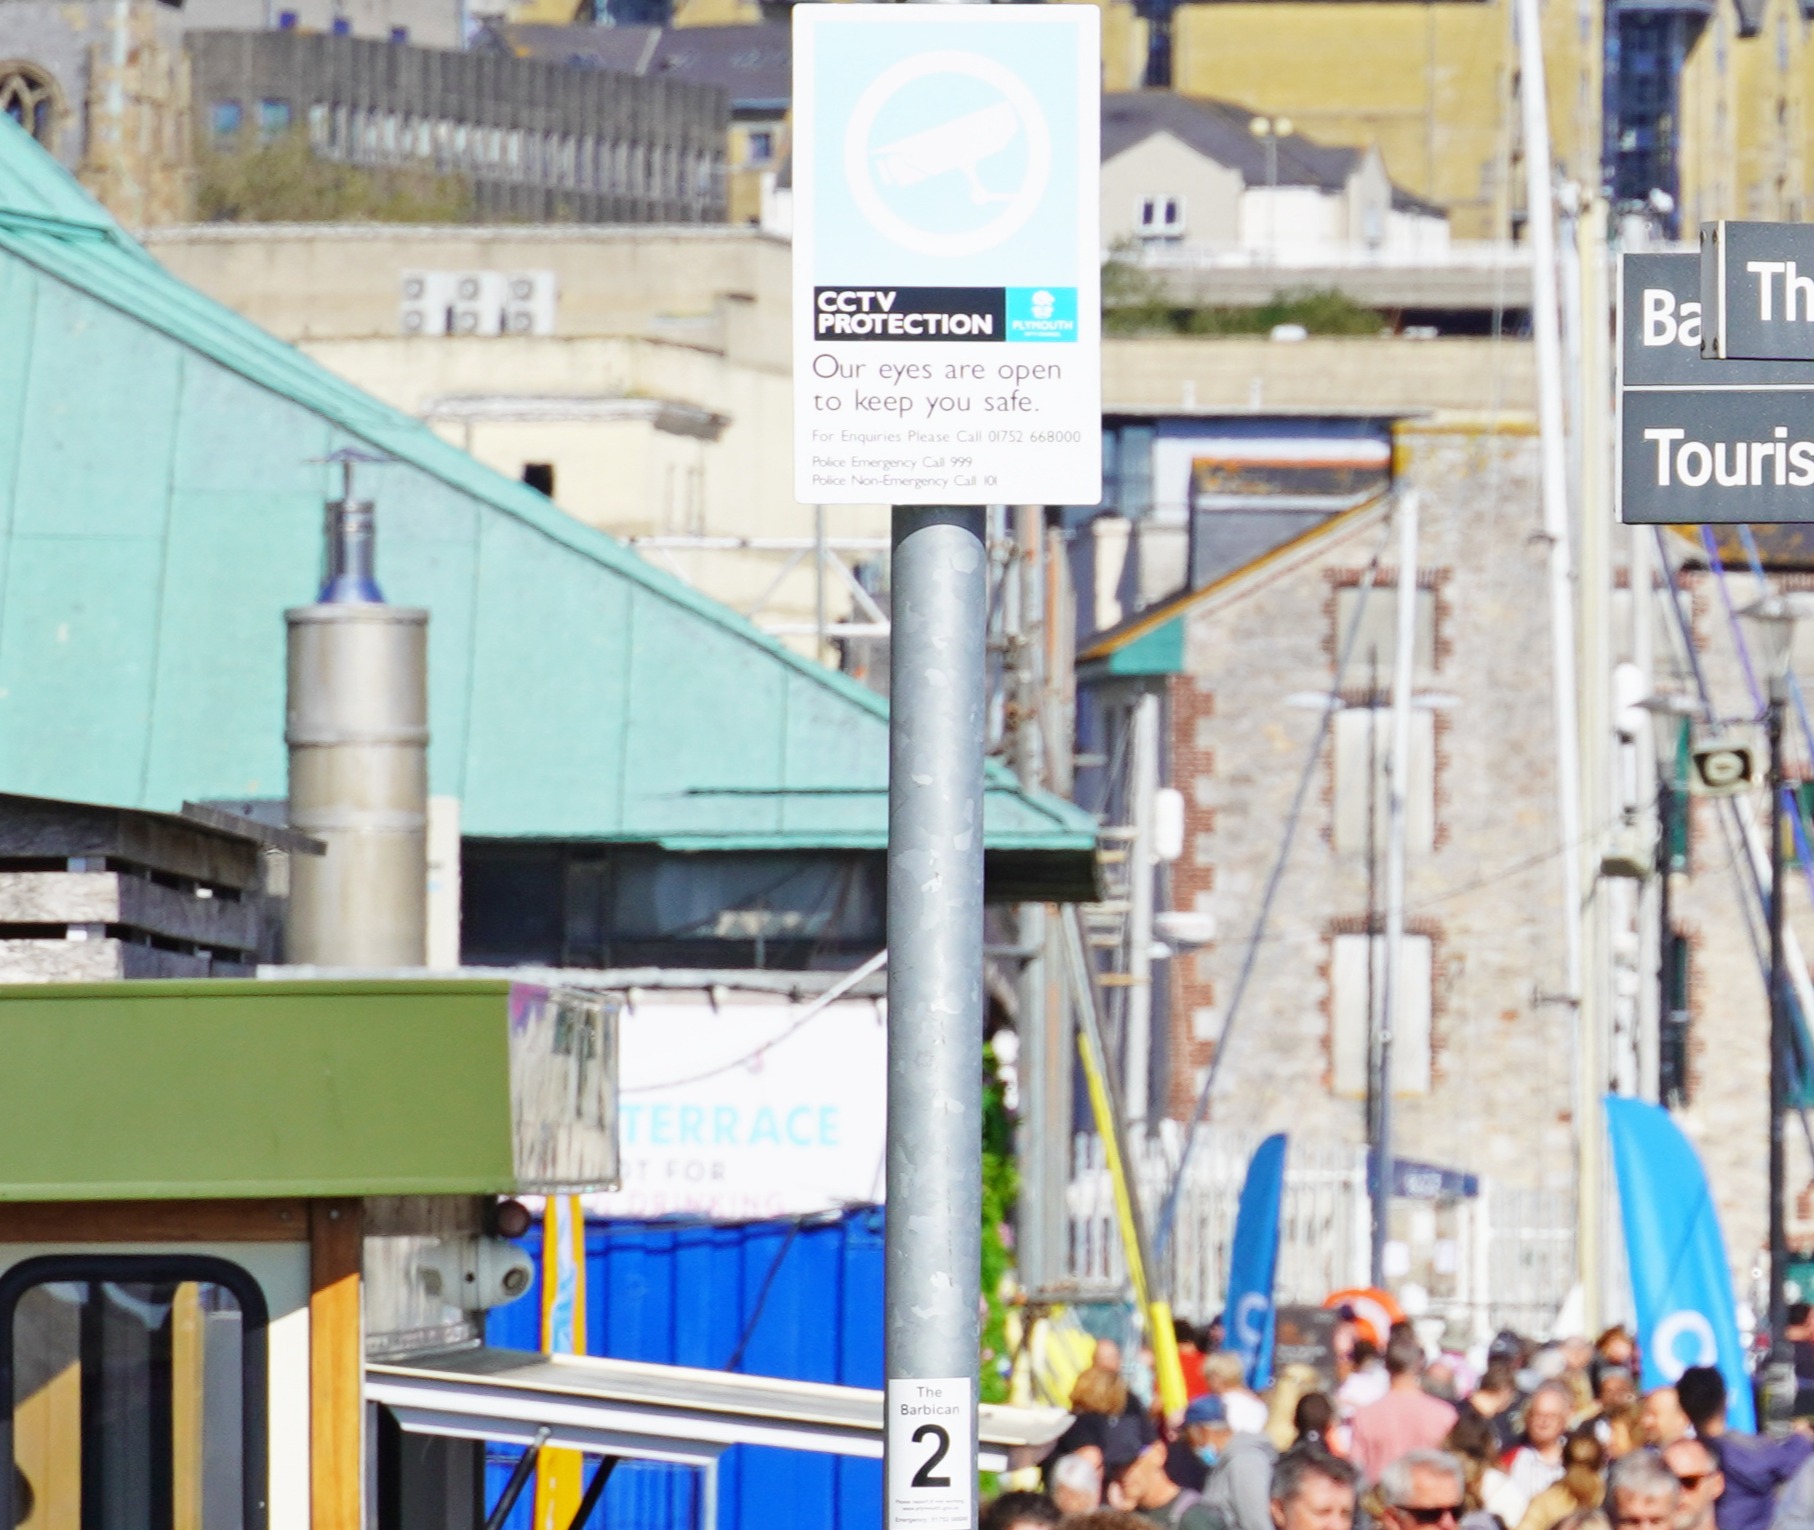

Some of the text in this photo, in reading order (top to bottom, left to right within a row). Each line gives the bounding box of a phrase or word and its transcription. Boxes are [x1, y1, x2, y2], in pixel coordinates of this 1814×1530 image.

[817, 290, 897, 311] CCTV
[818, 314, 993, 334] PROTECTION
[813, 354, 1061, 386] Our eyes are open
[814, 389, 1039, 418] to keep you safe.
[812, 429, 1081, 444] For Enquiries Please Call 01752 668000
[813, 456, 972, 471] Police Emergency Call 999
[813, 475, 846, 486] Police
[852, 475, 948, 489] Non-Emergency
[954, 475, 976, 486] Call
[620, 1105, 839, 1146] TERRACE
[665, 1160, 726, 1181] FOR
[917, 1387, 942, 1397] The
[901, 1404, 960, 1415] Barbican
[911, 1424, 951, 1487] 2
